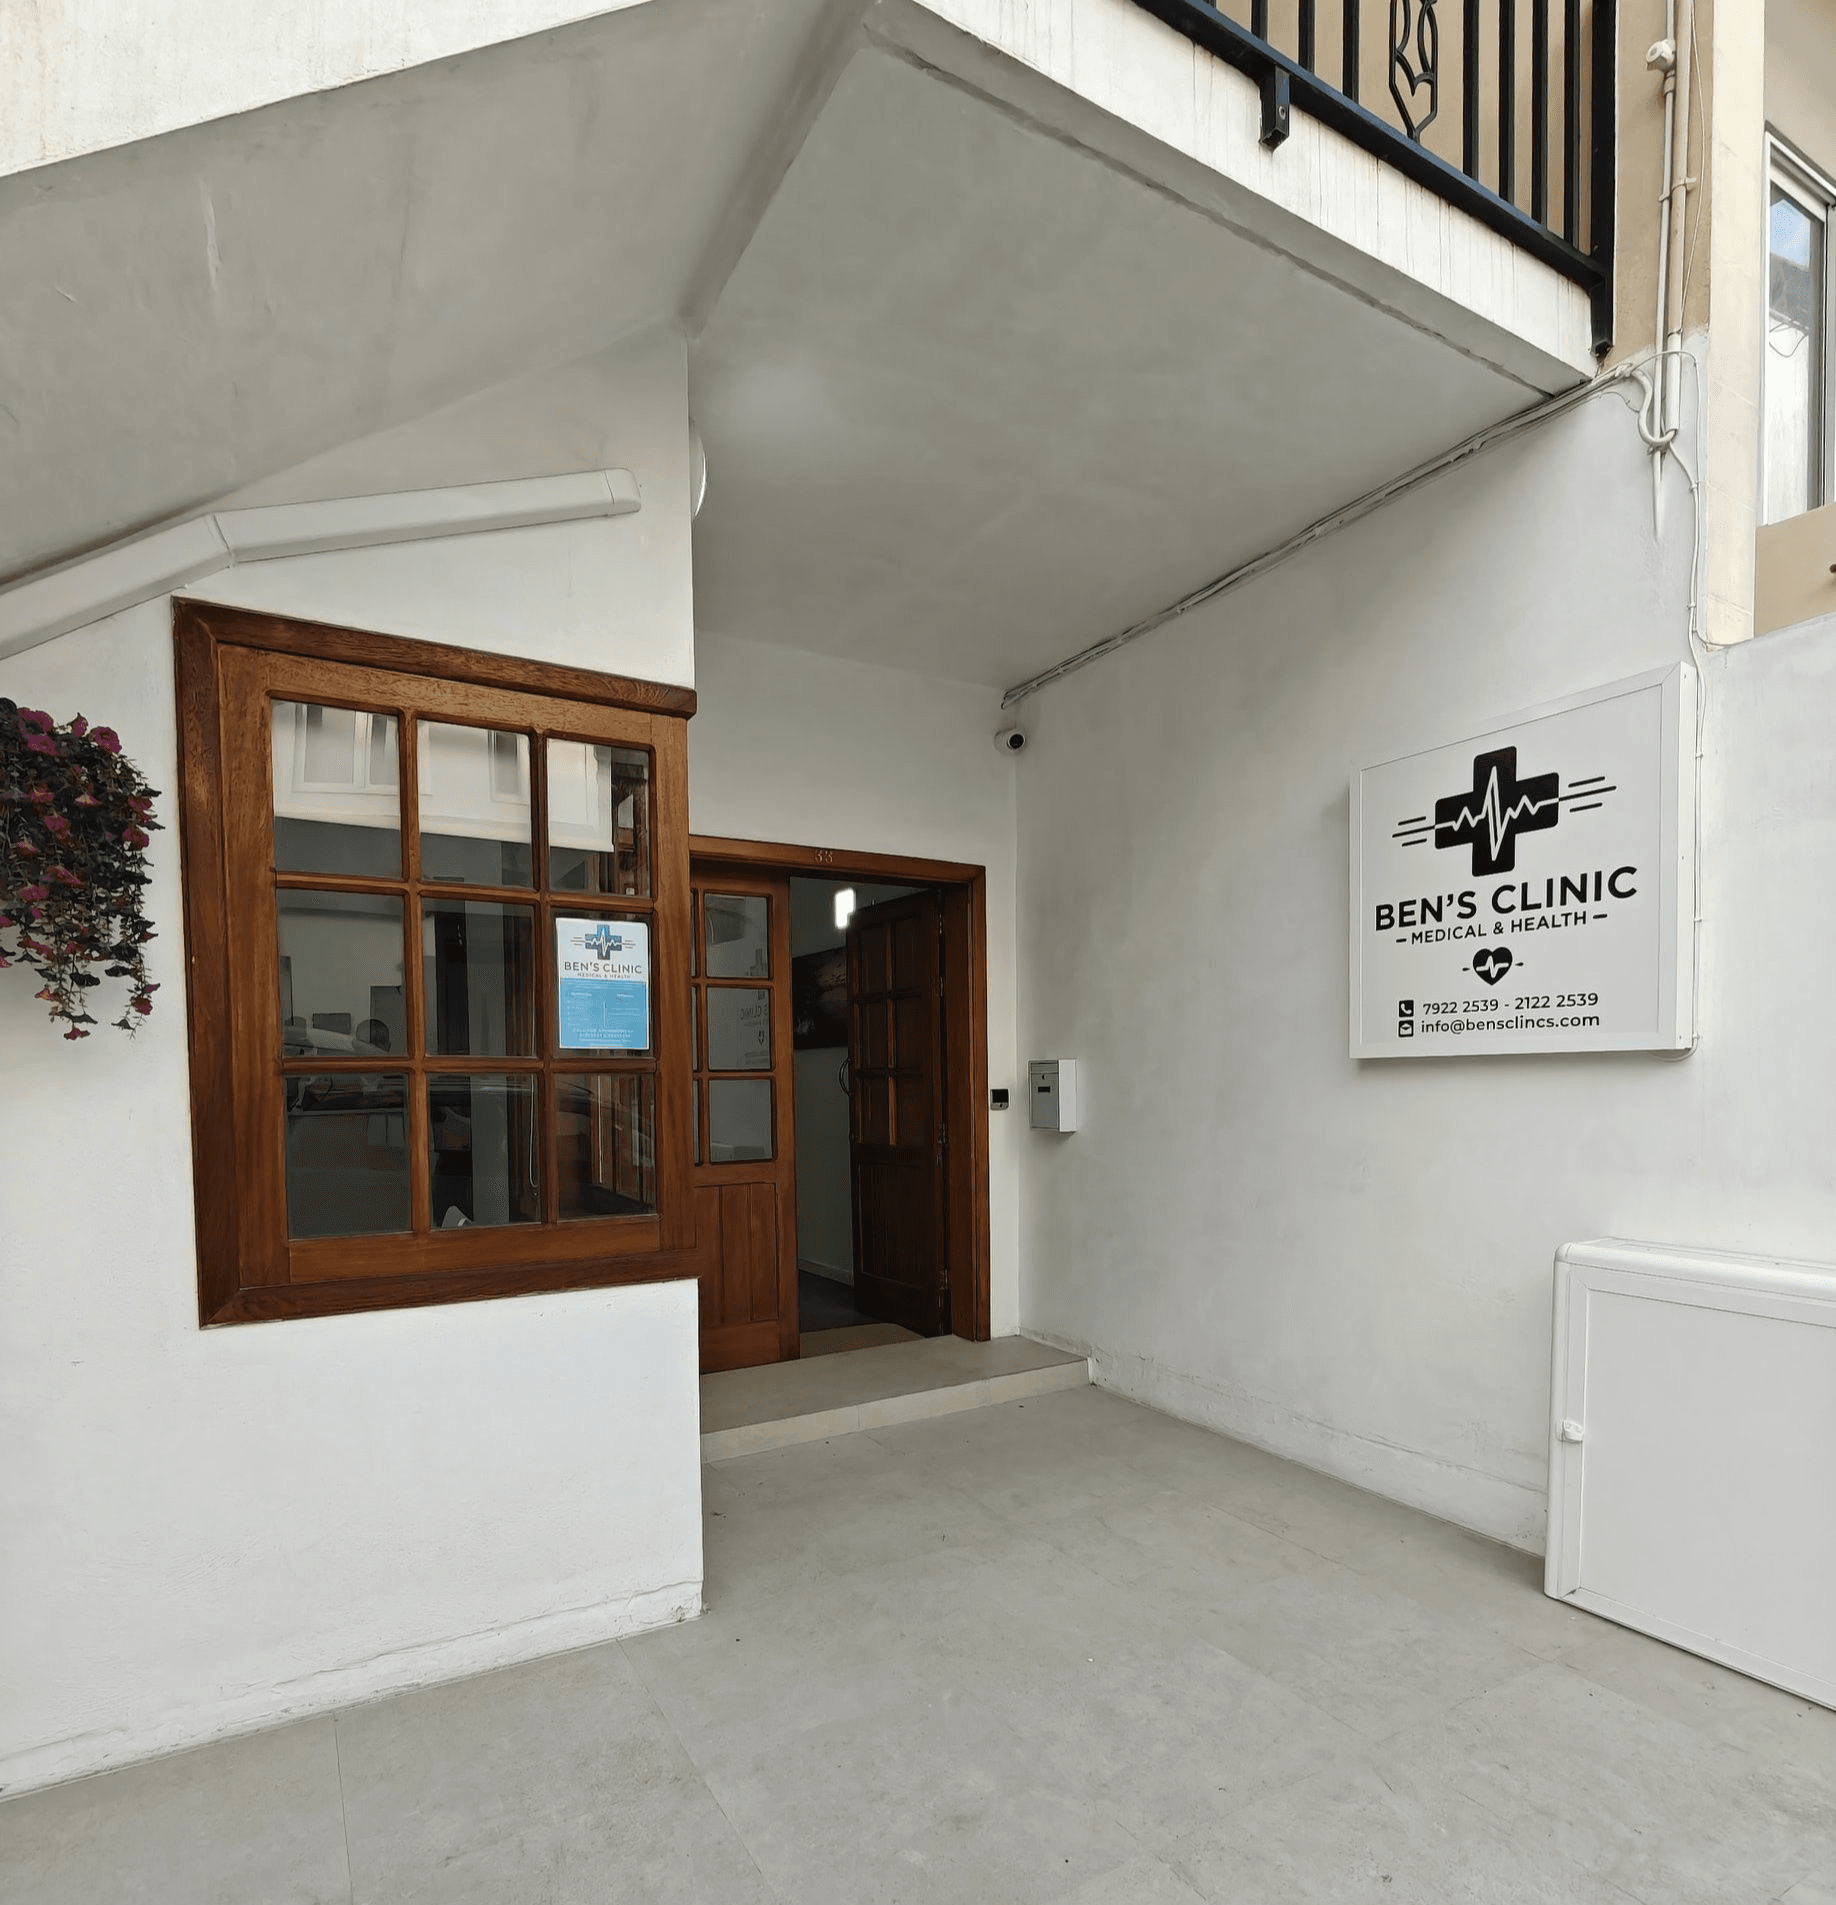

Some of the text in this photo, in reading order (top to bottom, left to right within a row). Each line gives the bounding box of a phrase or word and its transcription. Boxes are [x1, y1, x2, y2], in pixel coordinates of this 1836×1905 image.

[1375, 865, 1638, 932] BEN'S CLINIC
[1411, 910, 1587, 945] MEDICAL & HEALTH
[564, 961, 643, 975] BEN'S CLINIC
[1422, 1002, 1458, 1016] 7922
[1462, 999, 1499, 1013] 2539
[1514, 995, 1551, 1010] 2122
[1556, 992, 1599, 1008] 2539
[1421, 1015, 1600, 1035] info@bensclincs.com
